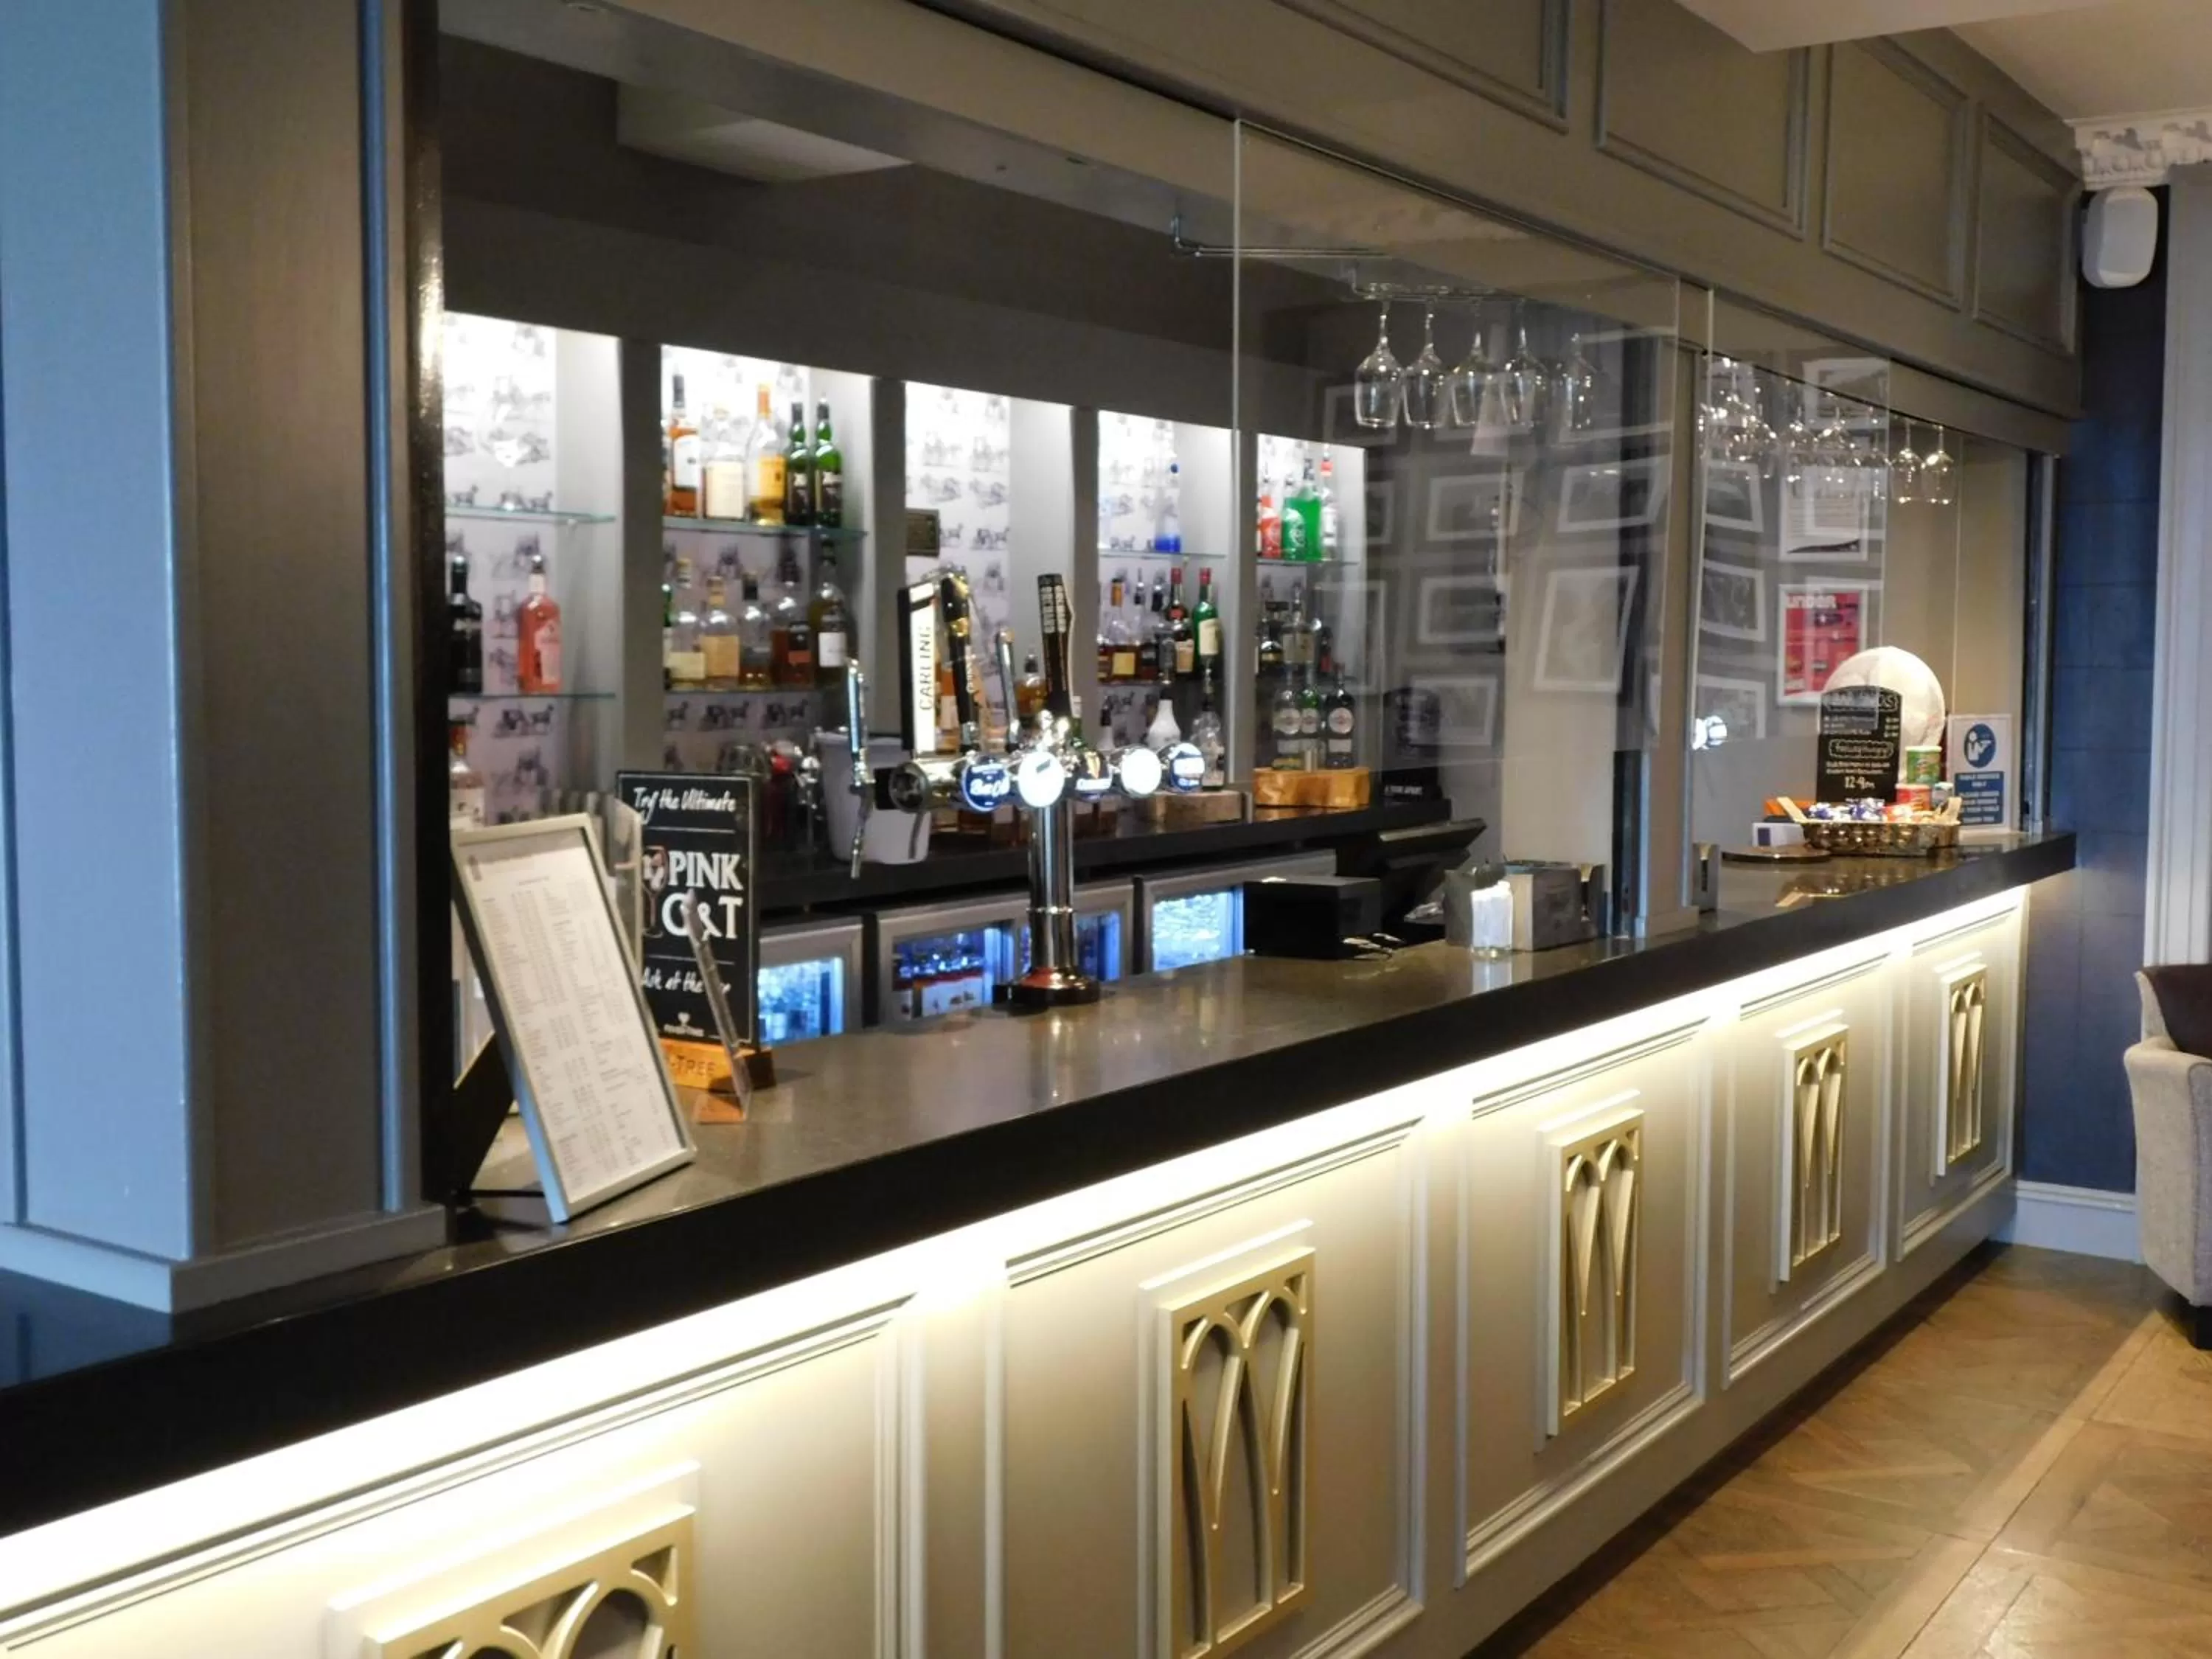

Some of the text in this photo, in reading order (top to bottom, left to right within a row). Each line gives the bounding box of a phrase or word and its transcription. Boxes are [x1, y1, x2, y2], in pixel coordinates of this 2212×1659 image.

[633, 786, 659, 825] Try
[658, 787, 680, 810] the
[667, 849, 744, 891] PINK
[664, 970, 682, 991] at
